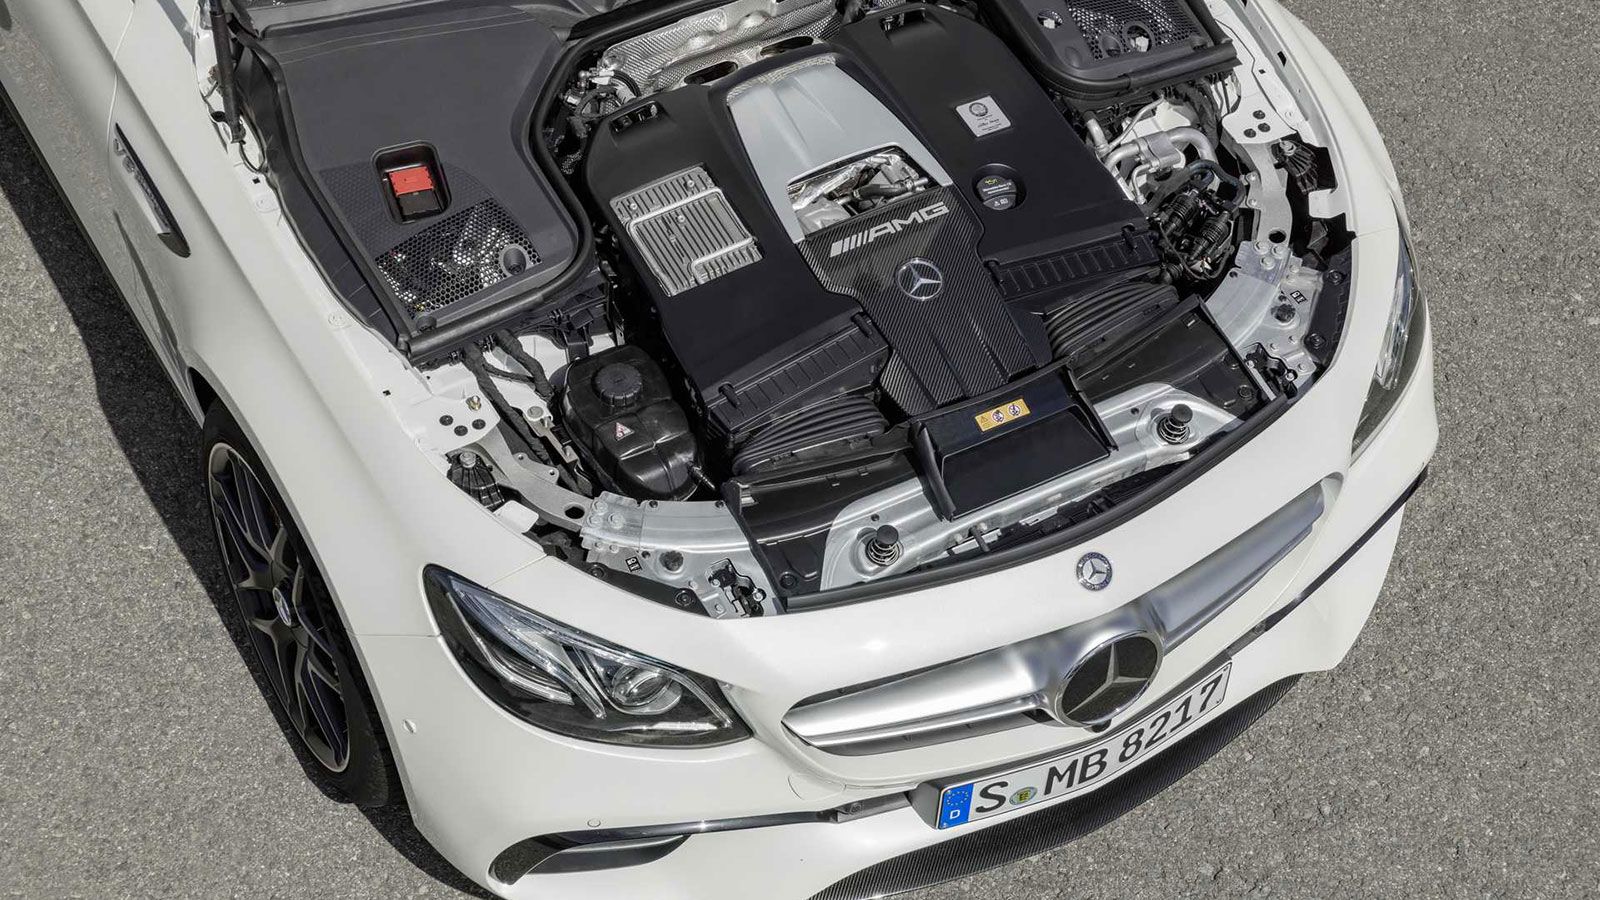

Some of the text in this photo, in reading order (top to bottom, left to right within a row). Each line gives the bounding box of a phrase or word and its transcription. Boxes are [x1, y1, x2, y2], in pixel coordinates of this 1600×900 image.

[867, 201, 950, 243] AMG
[975, 674, 1223, 813] S MB 8217
[949, 809, 961, 819] D
